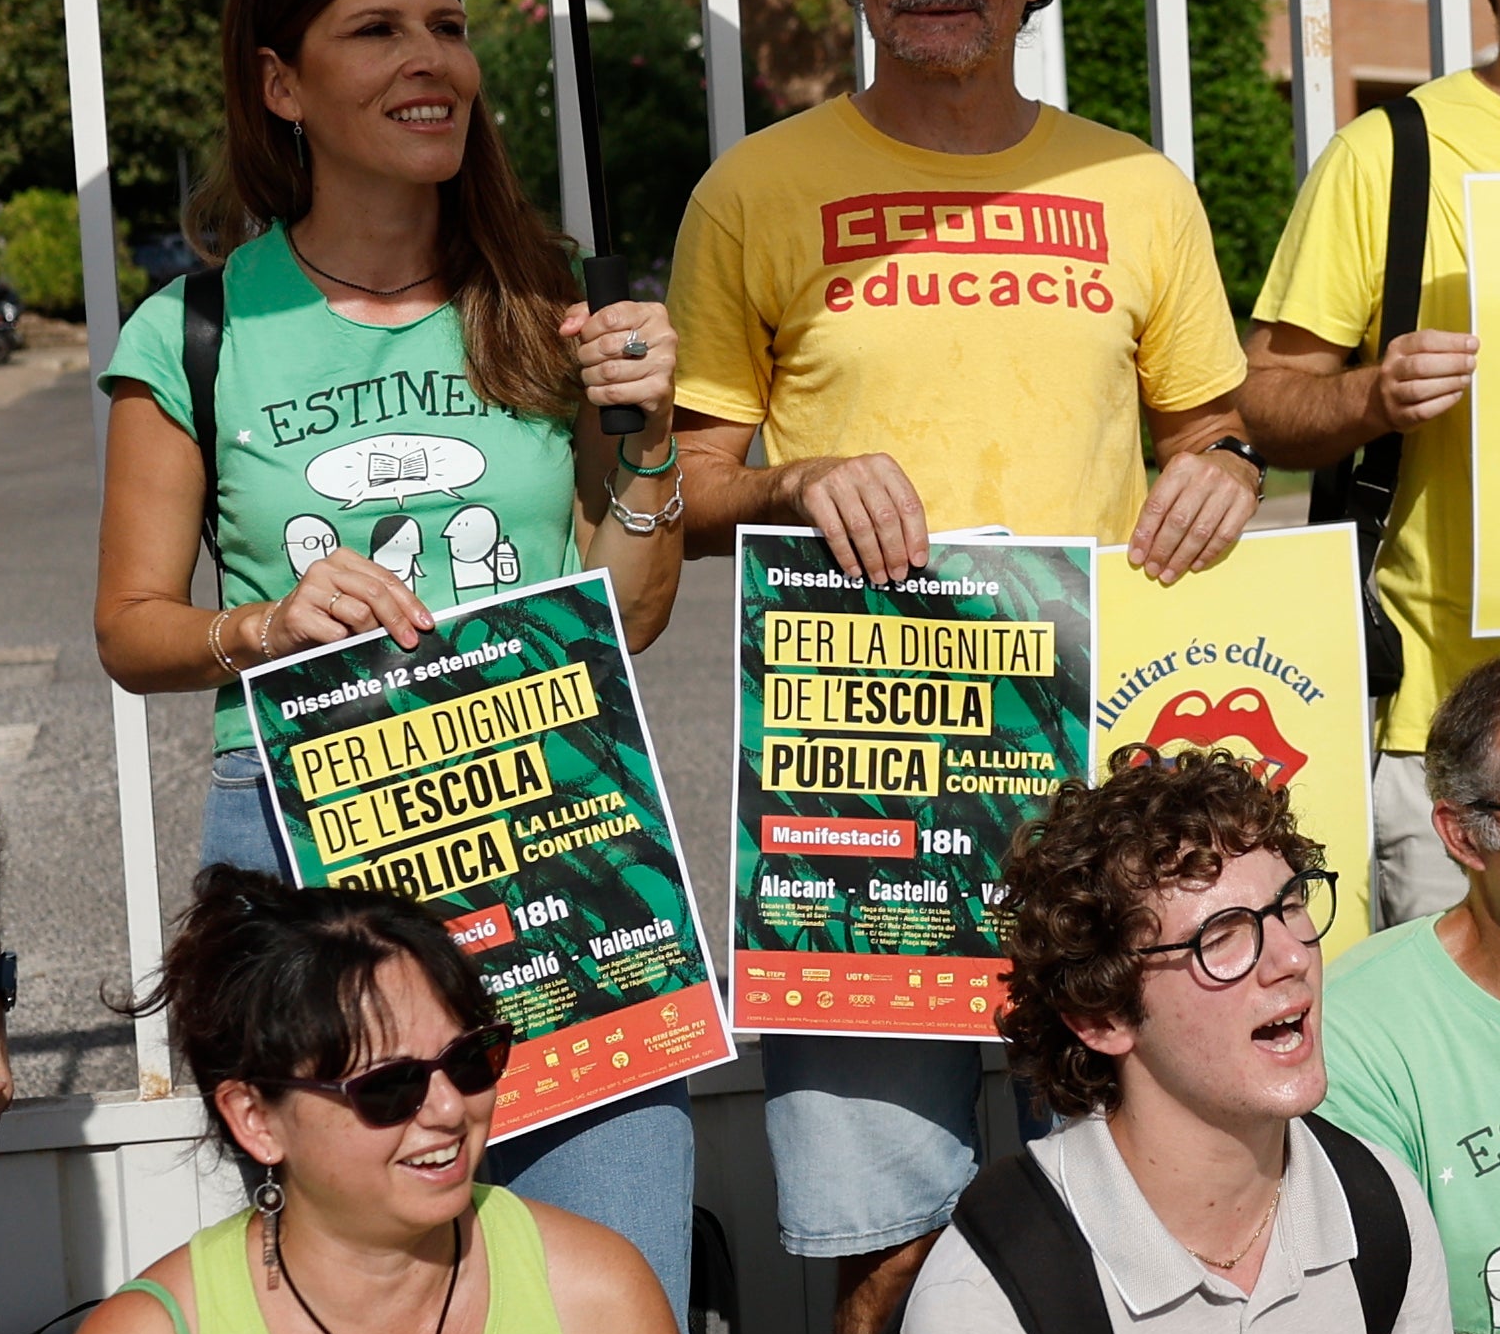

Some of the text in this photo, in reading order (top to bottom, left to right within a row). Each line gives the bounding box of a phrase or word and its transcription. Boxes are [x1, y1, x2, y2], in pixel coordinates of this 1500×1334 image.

[836, 205, 1025, 248] CCOO
[824, 262, 1114, 314] educació
[261, 370, 519, 448] ESTIME
[775, 619, 1042, 673] PER LA DIGNITAT
[281, 637, 521, 721] Dissabte 12 setembre
[771, 679, 984, 729] DE L'ESCOLA
[1096, 635, 1326, 733] lluitar és educar
[302, 671, 586, 795] PER LA DIGNITAT
[770, 737, 931, 793] PÚBLICA
[948, 749, 1051, 770] LA LLUITA
[312, 746, 545, 855] DE L'ESCOLA
[515, 790, 625, 839] LA LLUITA
[522, 812, 642, 863] CONTINUA
[773, 827, 972, 856] Manifestació 18h
[512, 892, 572, 933] 18h
[759, 876, 948, 904] Alacant Castelló
[587, 914, 676, 960] València
